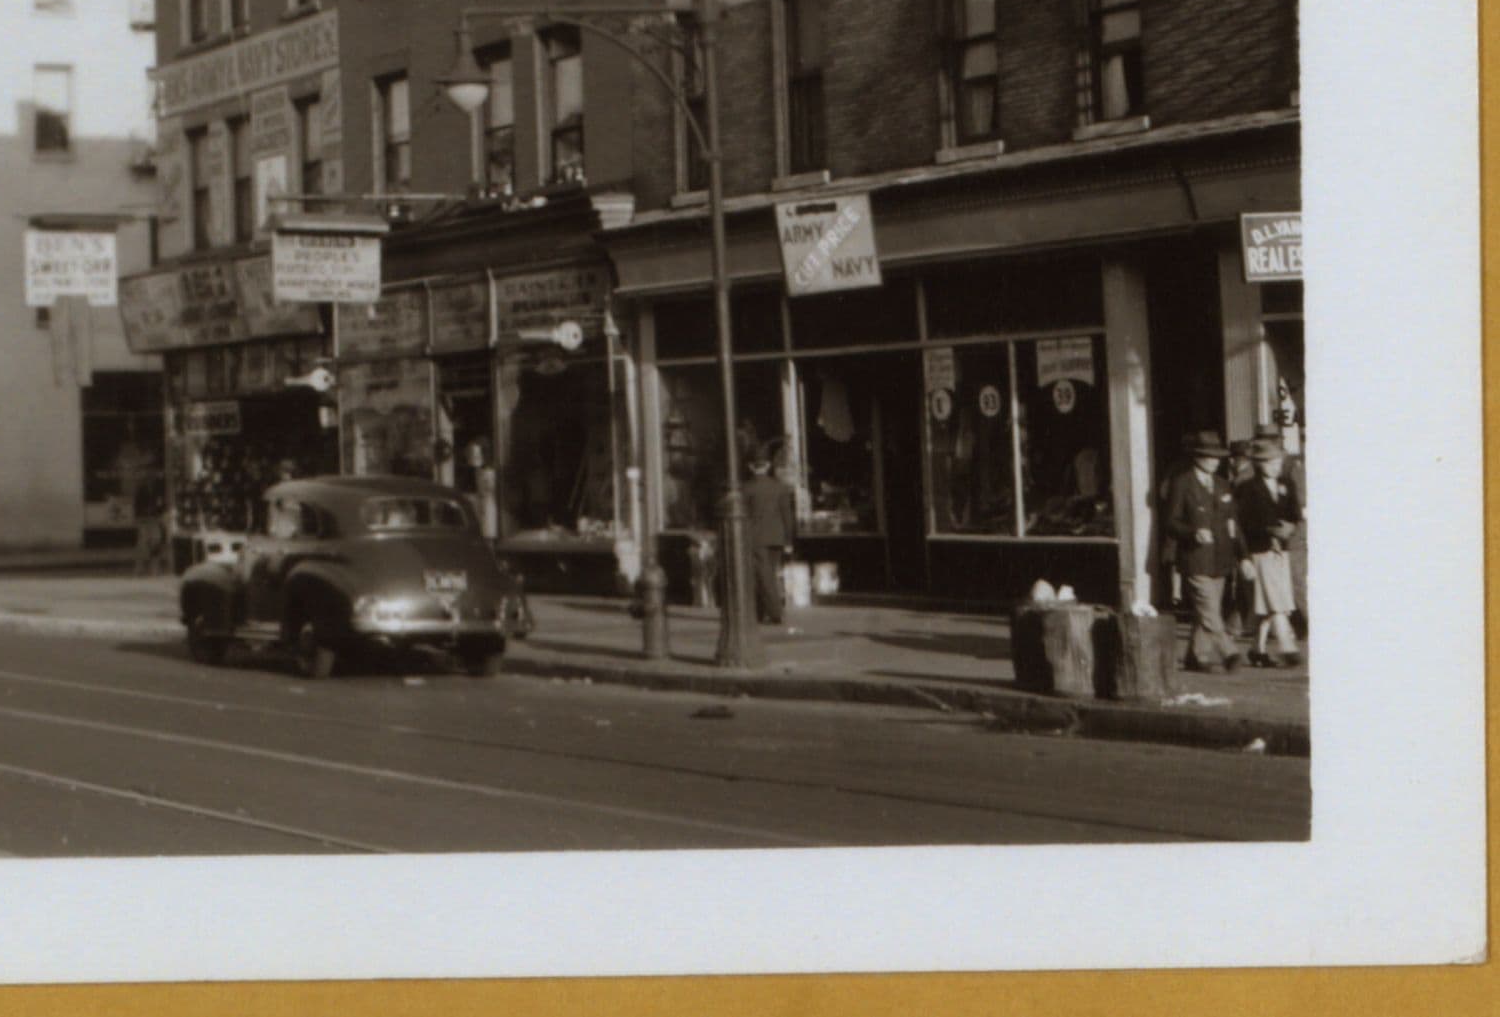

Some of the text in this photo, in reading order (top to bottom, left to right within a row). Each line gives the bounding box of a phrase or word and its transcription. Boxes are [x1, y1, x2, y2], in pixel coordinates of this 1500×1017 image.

[237, 38, 275, 85] NAVY
[276, 16, 339, 73] STORES
[783, 220, 824, 244] ARMY
[817, 206, 861, 257] PRICE
[831, 255, 874, 280] NAVY
[1247, 246, 1287, 273] REAL
